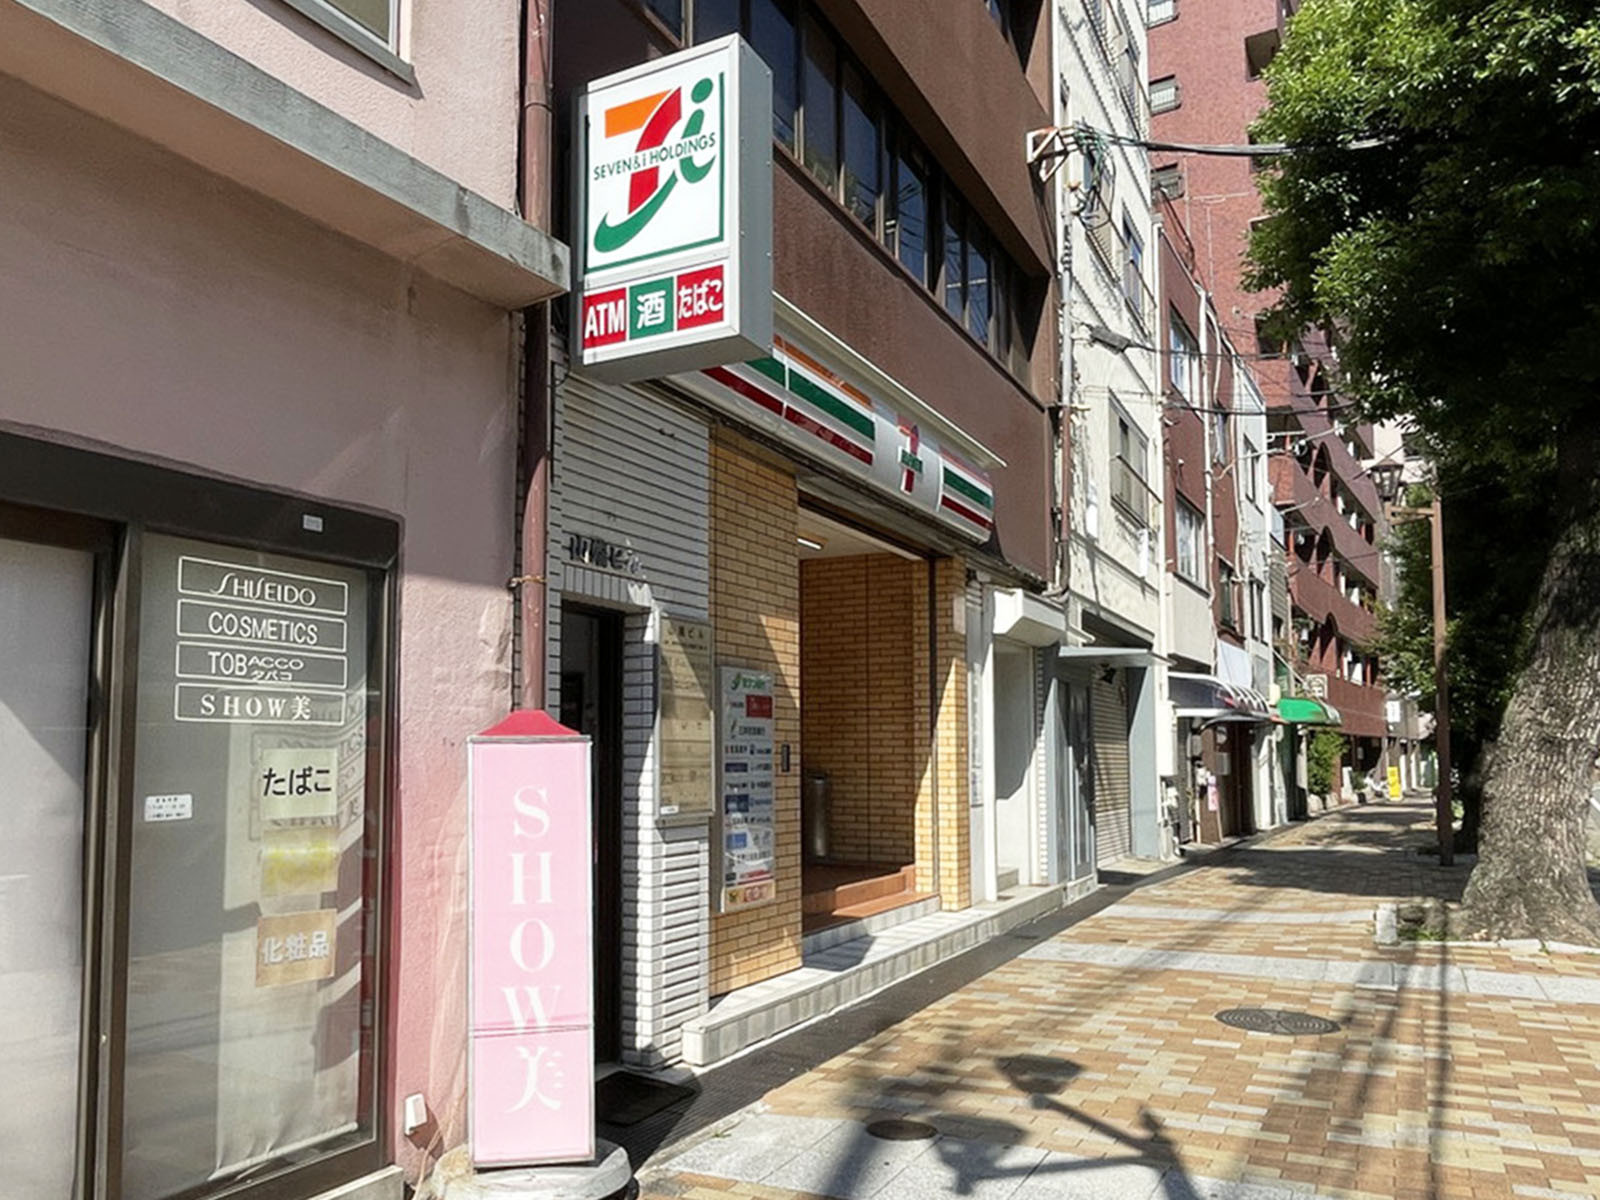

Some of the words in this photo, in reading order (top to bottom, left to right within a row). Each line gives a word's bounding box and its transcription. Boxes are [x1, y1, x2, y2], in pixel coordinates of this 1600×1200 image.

[649, 131, 716, 165] HOLDINGS
[636, 289, 667, 330] 酒
[678, 279, 724, 320] たばこ
[584, 299, 625, 339] ATM
[210, 573, 316, 606] SHISEIDO
[208, 611, 318, 646] COSMETICS
[208, 651, 304, 676] TOBACCO
[250, 670, 293, 682] タバコ
[263, 765, 332, 797] たばこ
[262, 930, 330, 965] 化粧品
